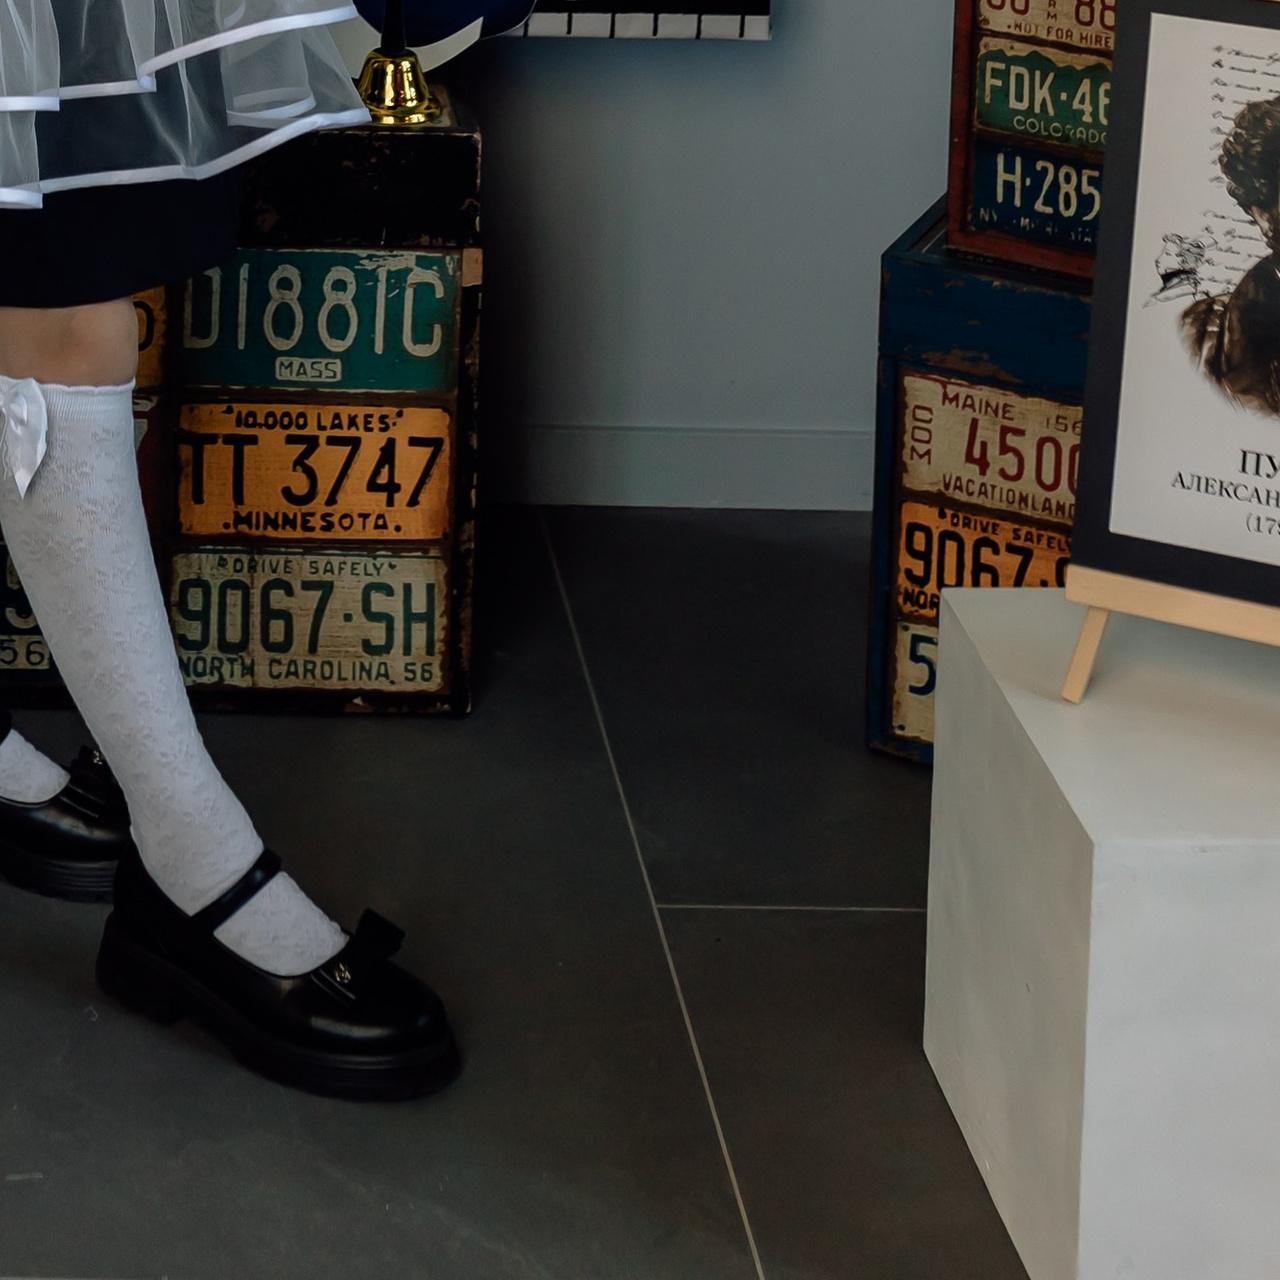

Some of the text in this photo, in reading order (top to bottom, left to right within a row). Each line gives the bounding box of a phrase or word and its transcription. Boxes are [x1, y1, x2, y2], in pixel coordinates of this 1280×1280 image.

[1046, 26, 1074, 42] FOR
[1079, 32, 1112, 48] HIRE
[280, 361, 338, 378] MASS
[942, 389, 1016, 421] MAINE
[179, 433, 444, 508] TT 3747
[950, 513, 1000, 535] DRIVE
[1245, 512, 1280, 536] (17
[233, 557, 385, 577] DRIVE SAFELY
[180, 655, 433, 683] NORTH CAROLINA 56
